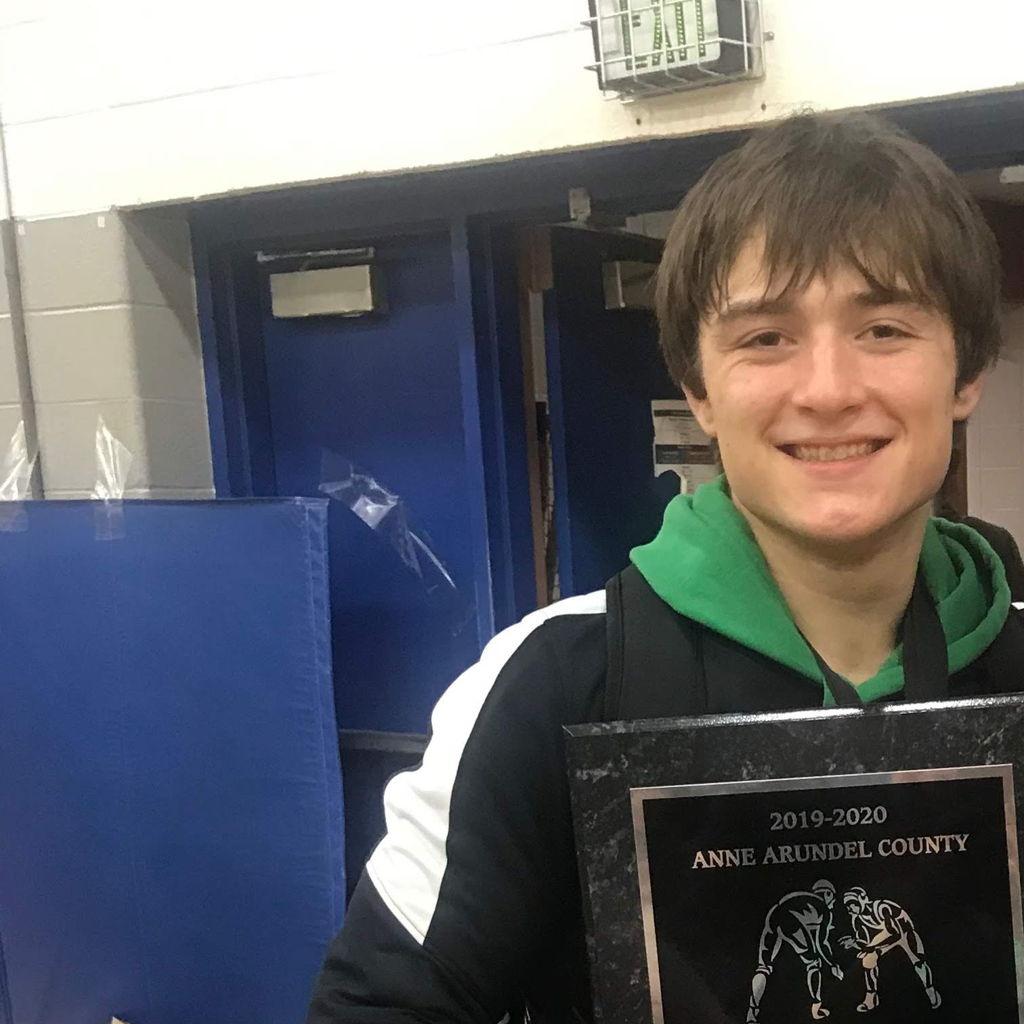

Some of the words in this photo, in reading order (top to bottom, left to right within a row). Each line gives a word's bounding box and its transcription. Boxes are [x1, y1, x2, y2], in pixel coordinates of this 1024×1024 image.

[770, 805, 888, 831] 2019-2020
[691, 847, 756, 870] ANNE
[762, 840, 873, 865] ARUNDEL
[877, 833, 970, 857] COUNTY
